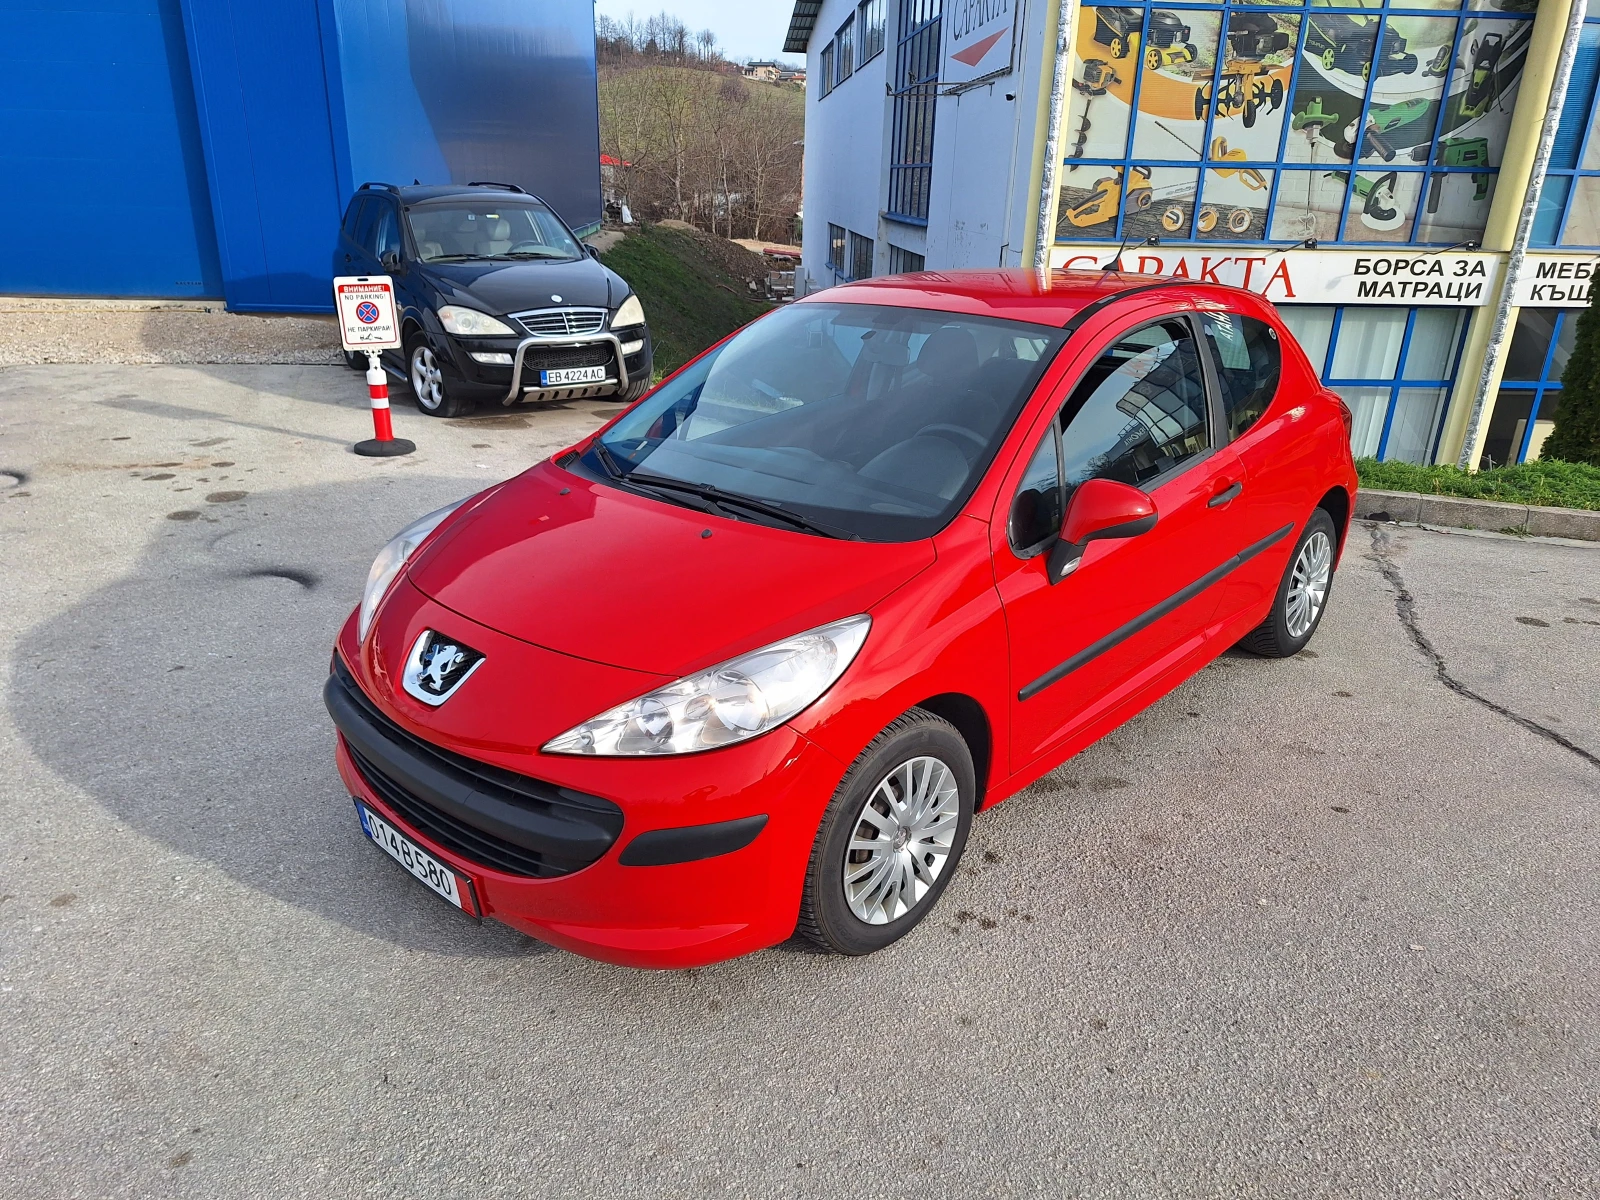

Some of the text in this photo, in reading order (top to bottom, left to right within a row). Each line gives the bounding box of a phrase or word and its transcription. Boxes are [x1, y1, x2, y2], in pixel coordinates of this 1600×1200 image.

[1353, 258, 1487, 278] БОРСА ЗА
[343, 285, 385, 293] ВНИМАНИЕ!
[1357, 281, 1483, 301] МАТРАЦИ
[548, 371, 562, 383] EB
[564, 369, 588, 382] 4224
[591, 368, 603, 380] AC
[368, 814, 452, 896] 014B580
